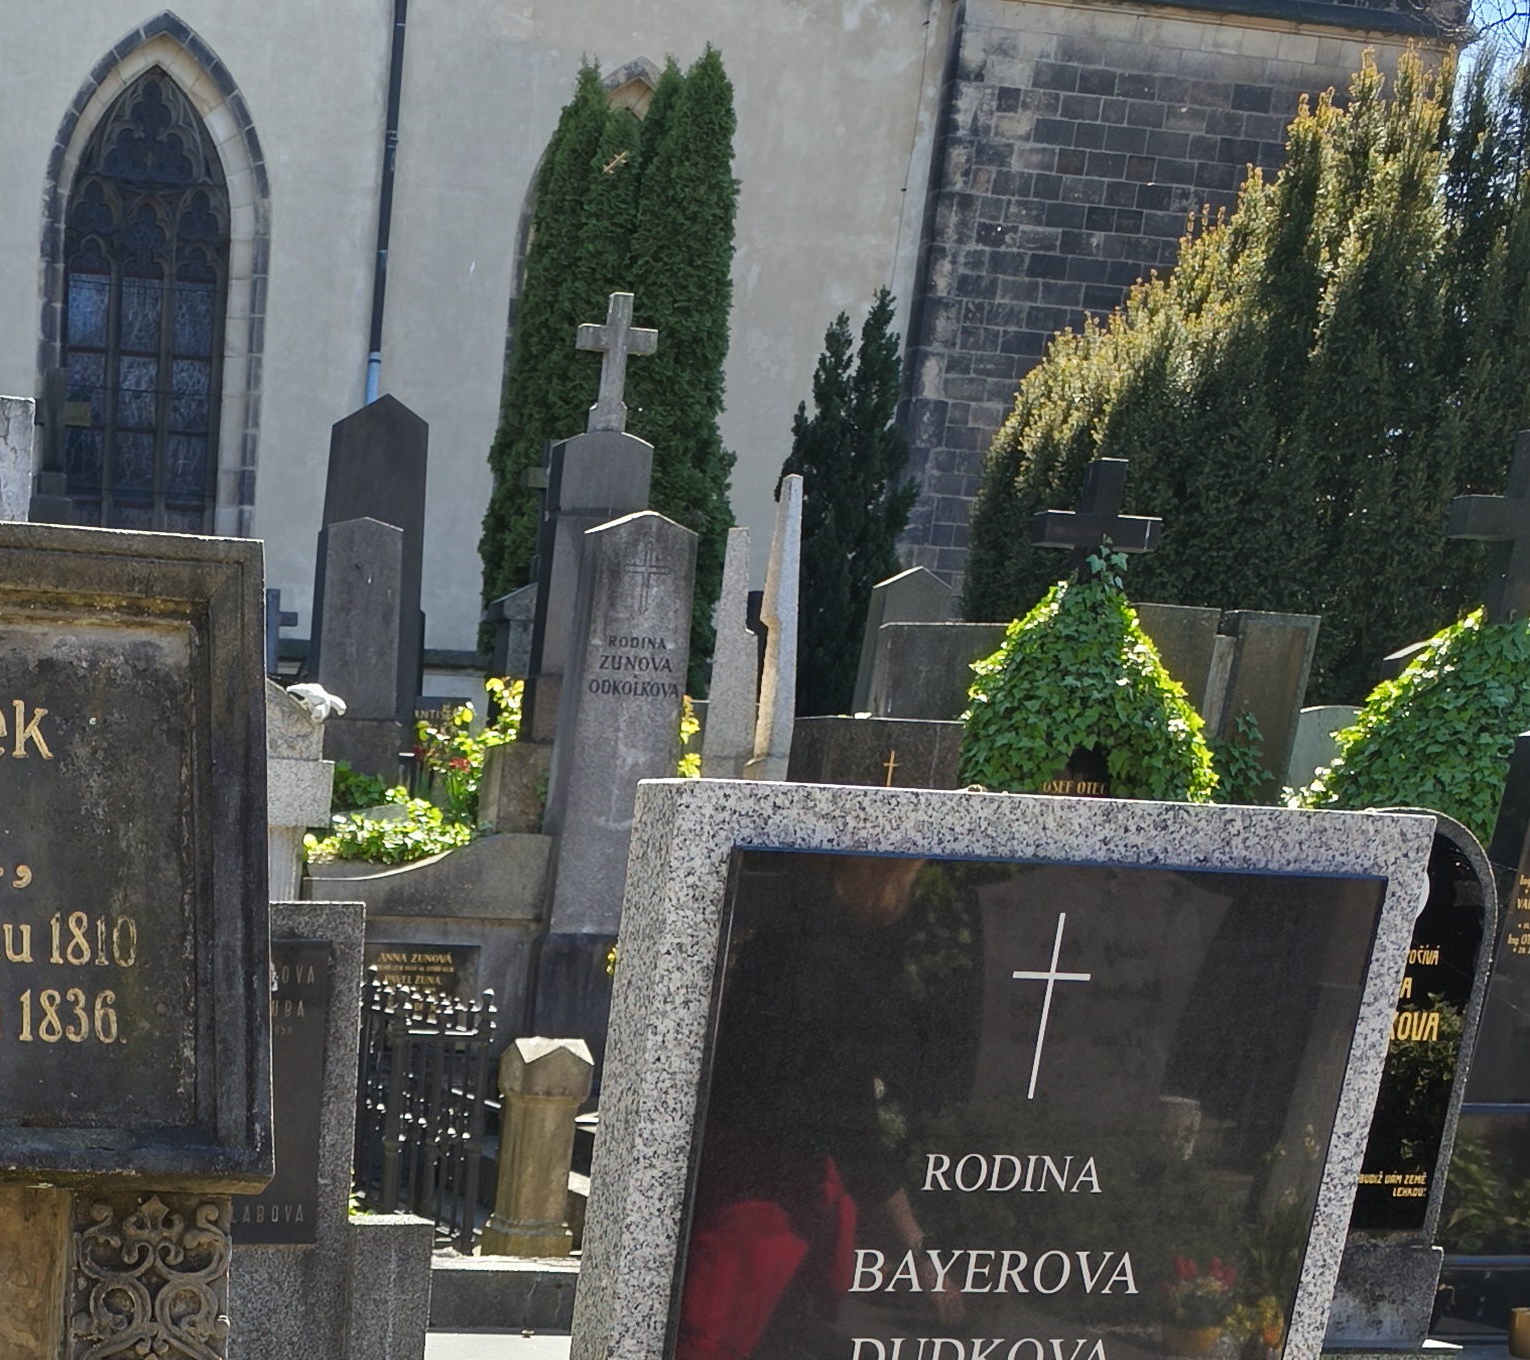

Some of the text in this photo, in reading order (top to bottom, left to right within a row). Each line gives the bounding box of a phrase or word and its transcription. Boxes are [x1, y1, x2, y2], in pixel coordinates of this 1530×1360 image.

[608, 635, 667, 650] RODINA
[599, 655, 672, 673] ZUNOVA
[589, 679, 679, 698] ODKOLKOVA
[50, 911, 137, 967] 1810
[921, 1153, 1102, 1193] RODINA
[848, 1249, 1139, 1294] BAYEROVA
